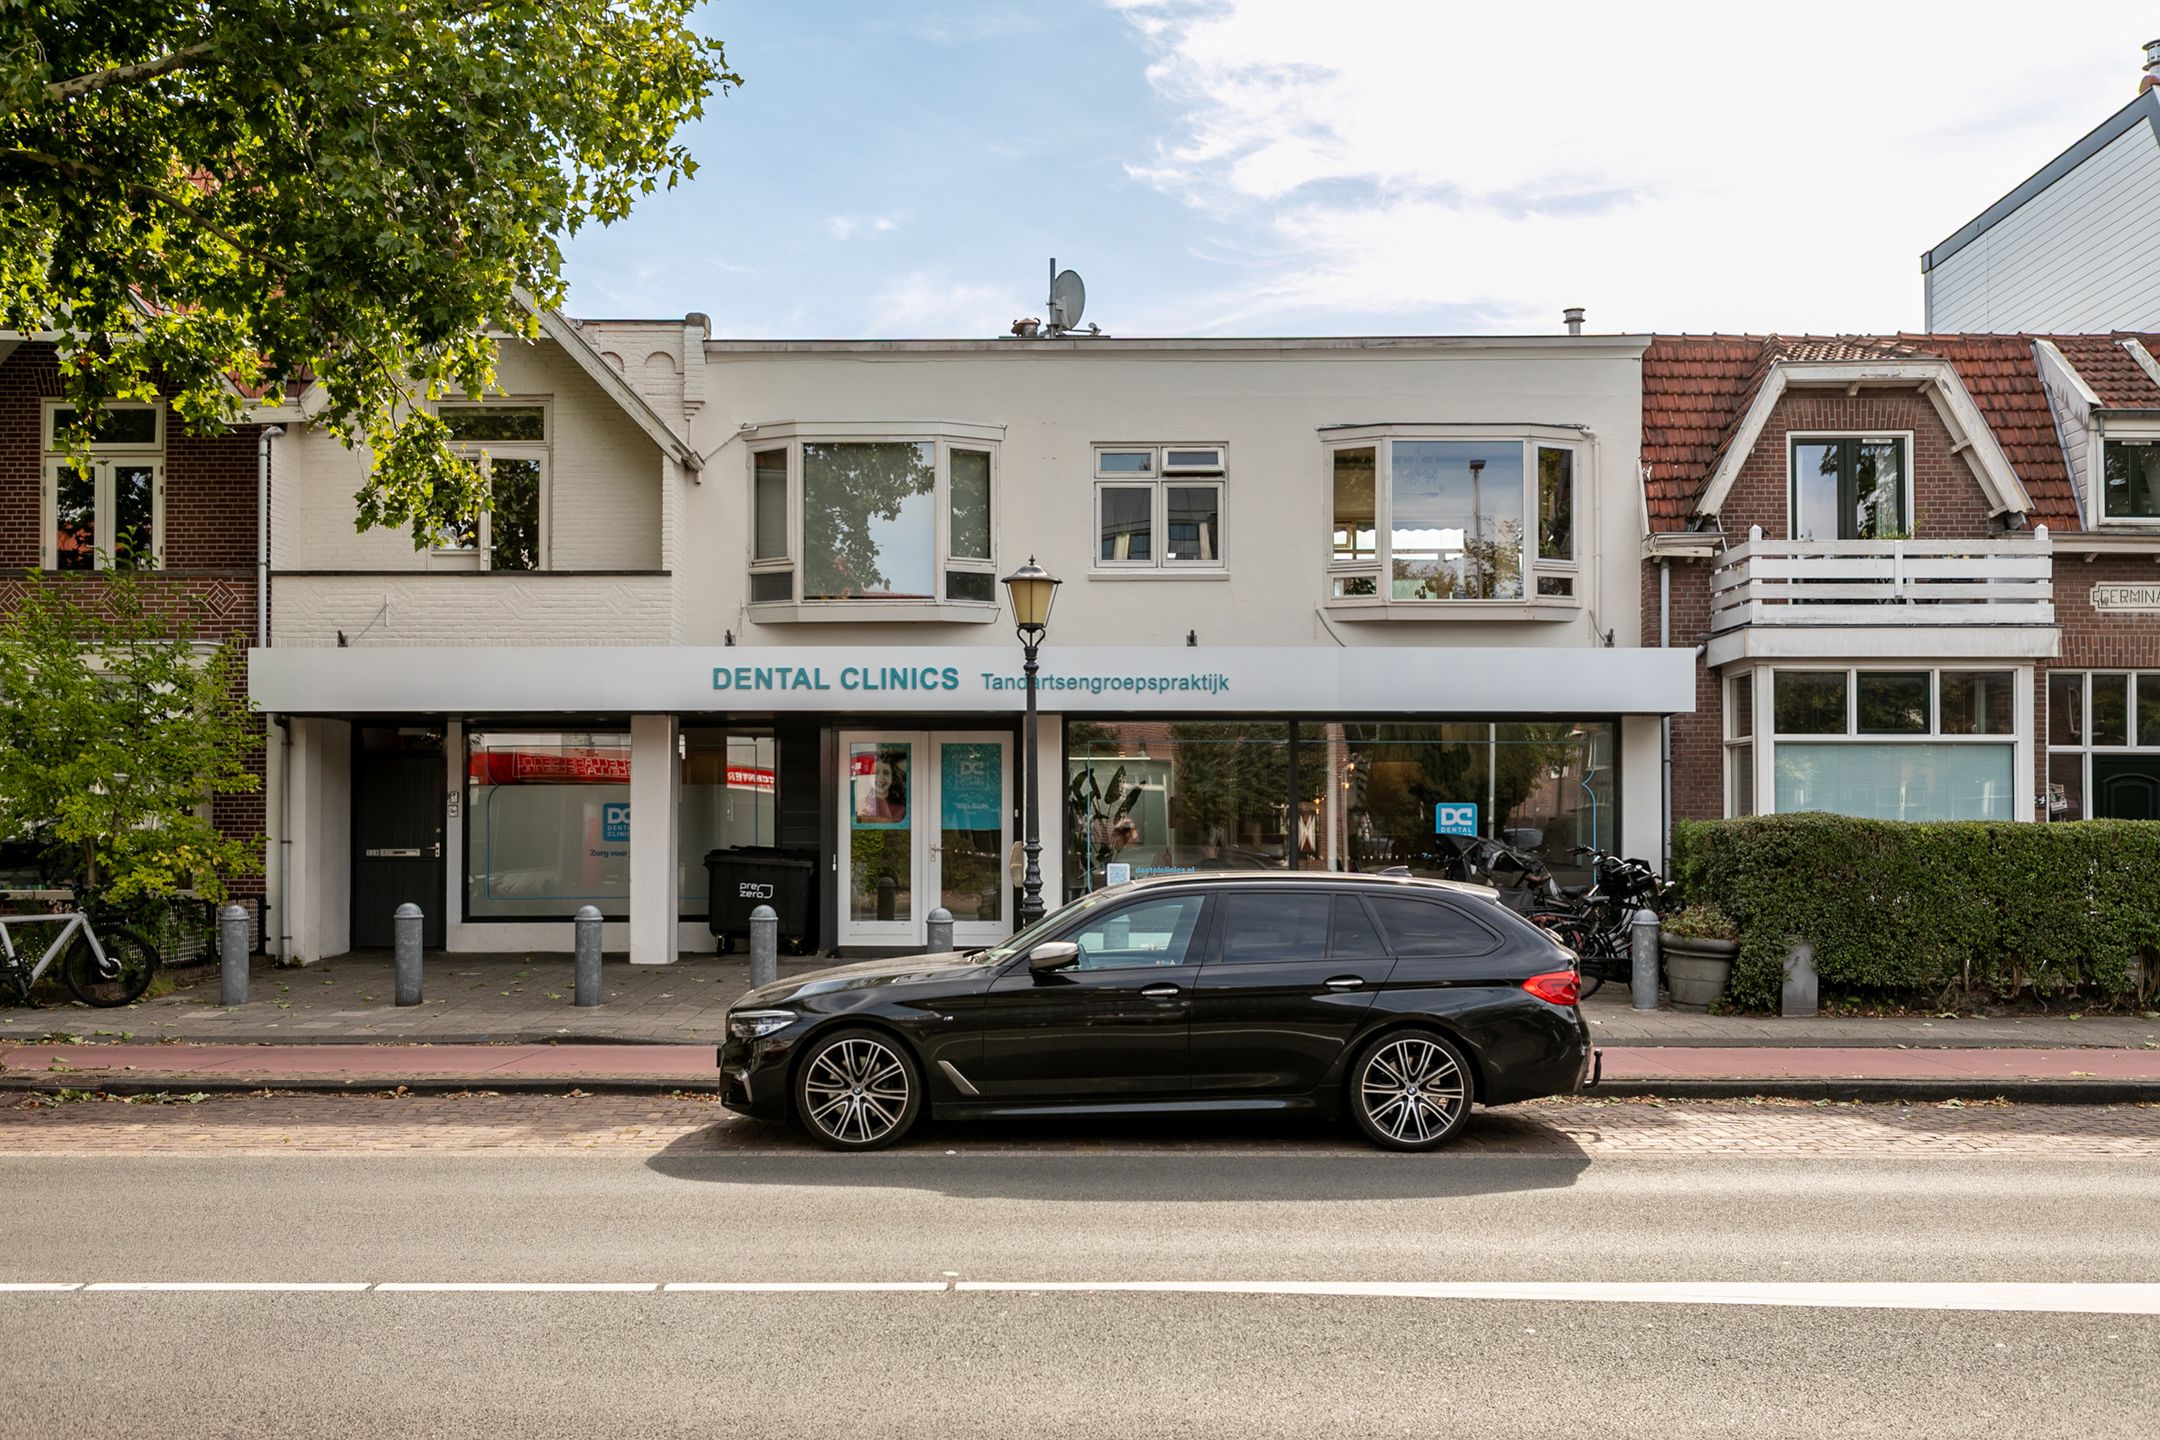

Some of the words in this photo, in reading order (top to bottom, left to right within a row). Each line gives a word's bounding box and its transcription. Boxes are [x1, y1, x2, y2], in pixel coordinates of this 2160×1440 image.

[713, 667, 830, 690] DENTAL
[840, 667, 960, 690] CLINICS
[1441, 808, 1472, 825] DC
[740, 890, 764, 898] zero
